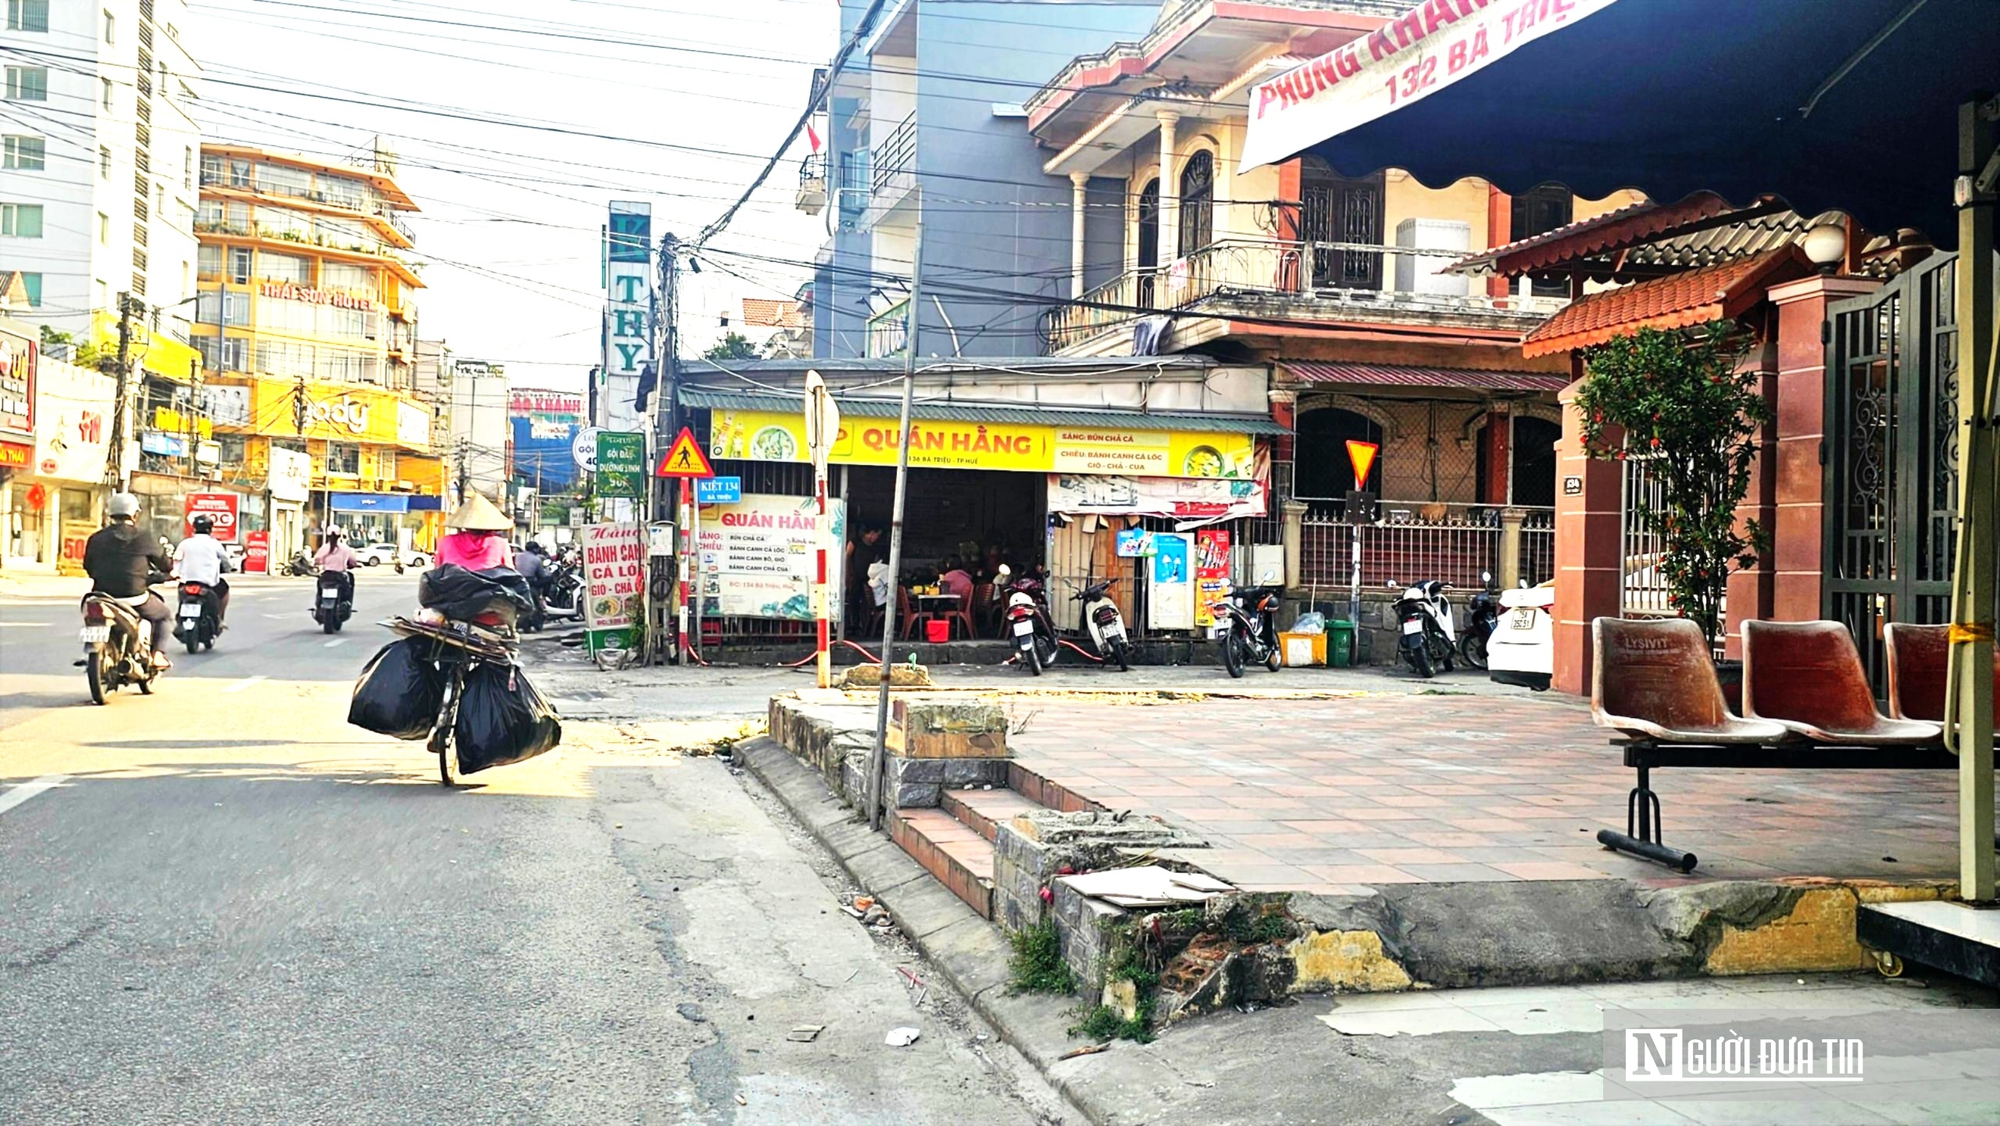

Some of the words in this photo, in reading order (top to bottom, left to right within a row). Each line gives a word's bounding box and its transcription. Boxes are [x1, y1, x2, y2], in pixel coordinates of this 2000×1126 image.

[1385, 55, 1437, 105] 132
[1447, 22, 1489, 76] BÀ
[863, 424, 945, 452] QUÁN
[951, 424, 1032, 455] HẰNG
[1062, 432, 1086, 440] SÁNG:
[1087, 433, 1104, 441] BÚN
[1105, 433, 1121, 442] CHẢ
[1123, 434, 1134, 442] CÁ
[1088, 451, 1111, 459] BÁNH
[1135, 452, 1146, 460] CÁ
[701, 479, 723, 493] KIỆT
[725, 481, 739, 491] 134
[721, 510, 773, 528] QUÁN
[778, 509, 816, 530] HẰN
[587, 542, 618, 565] BÁNH
[729, 553, 745, 561] BÁNH
[592, 564, 614, 580] CÁ
[618, 563, 638, 577] LÓ
[591, 581, 607, 597] GIÒ
[614, 577, 633, 594] CHẢ
[1624, 636, 1669, 649] LYSIVIT
